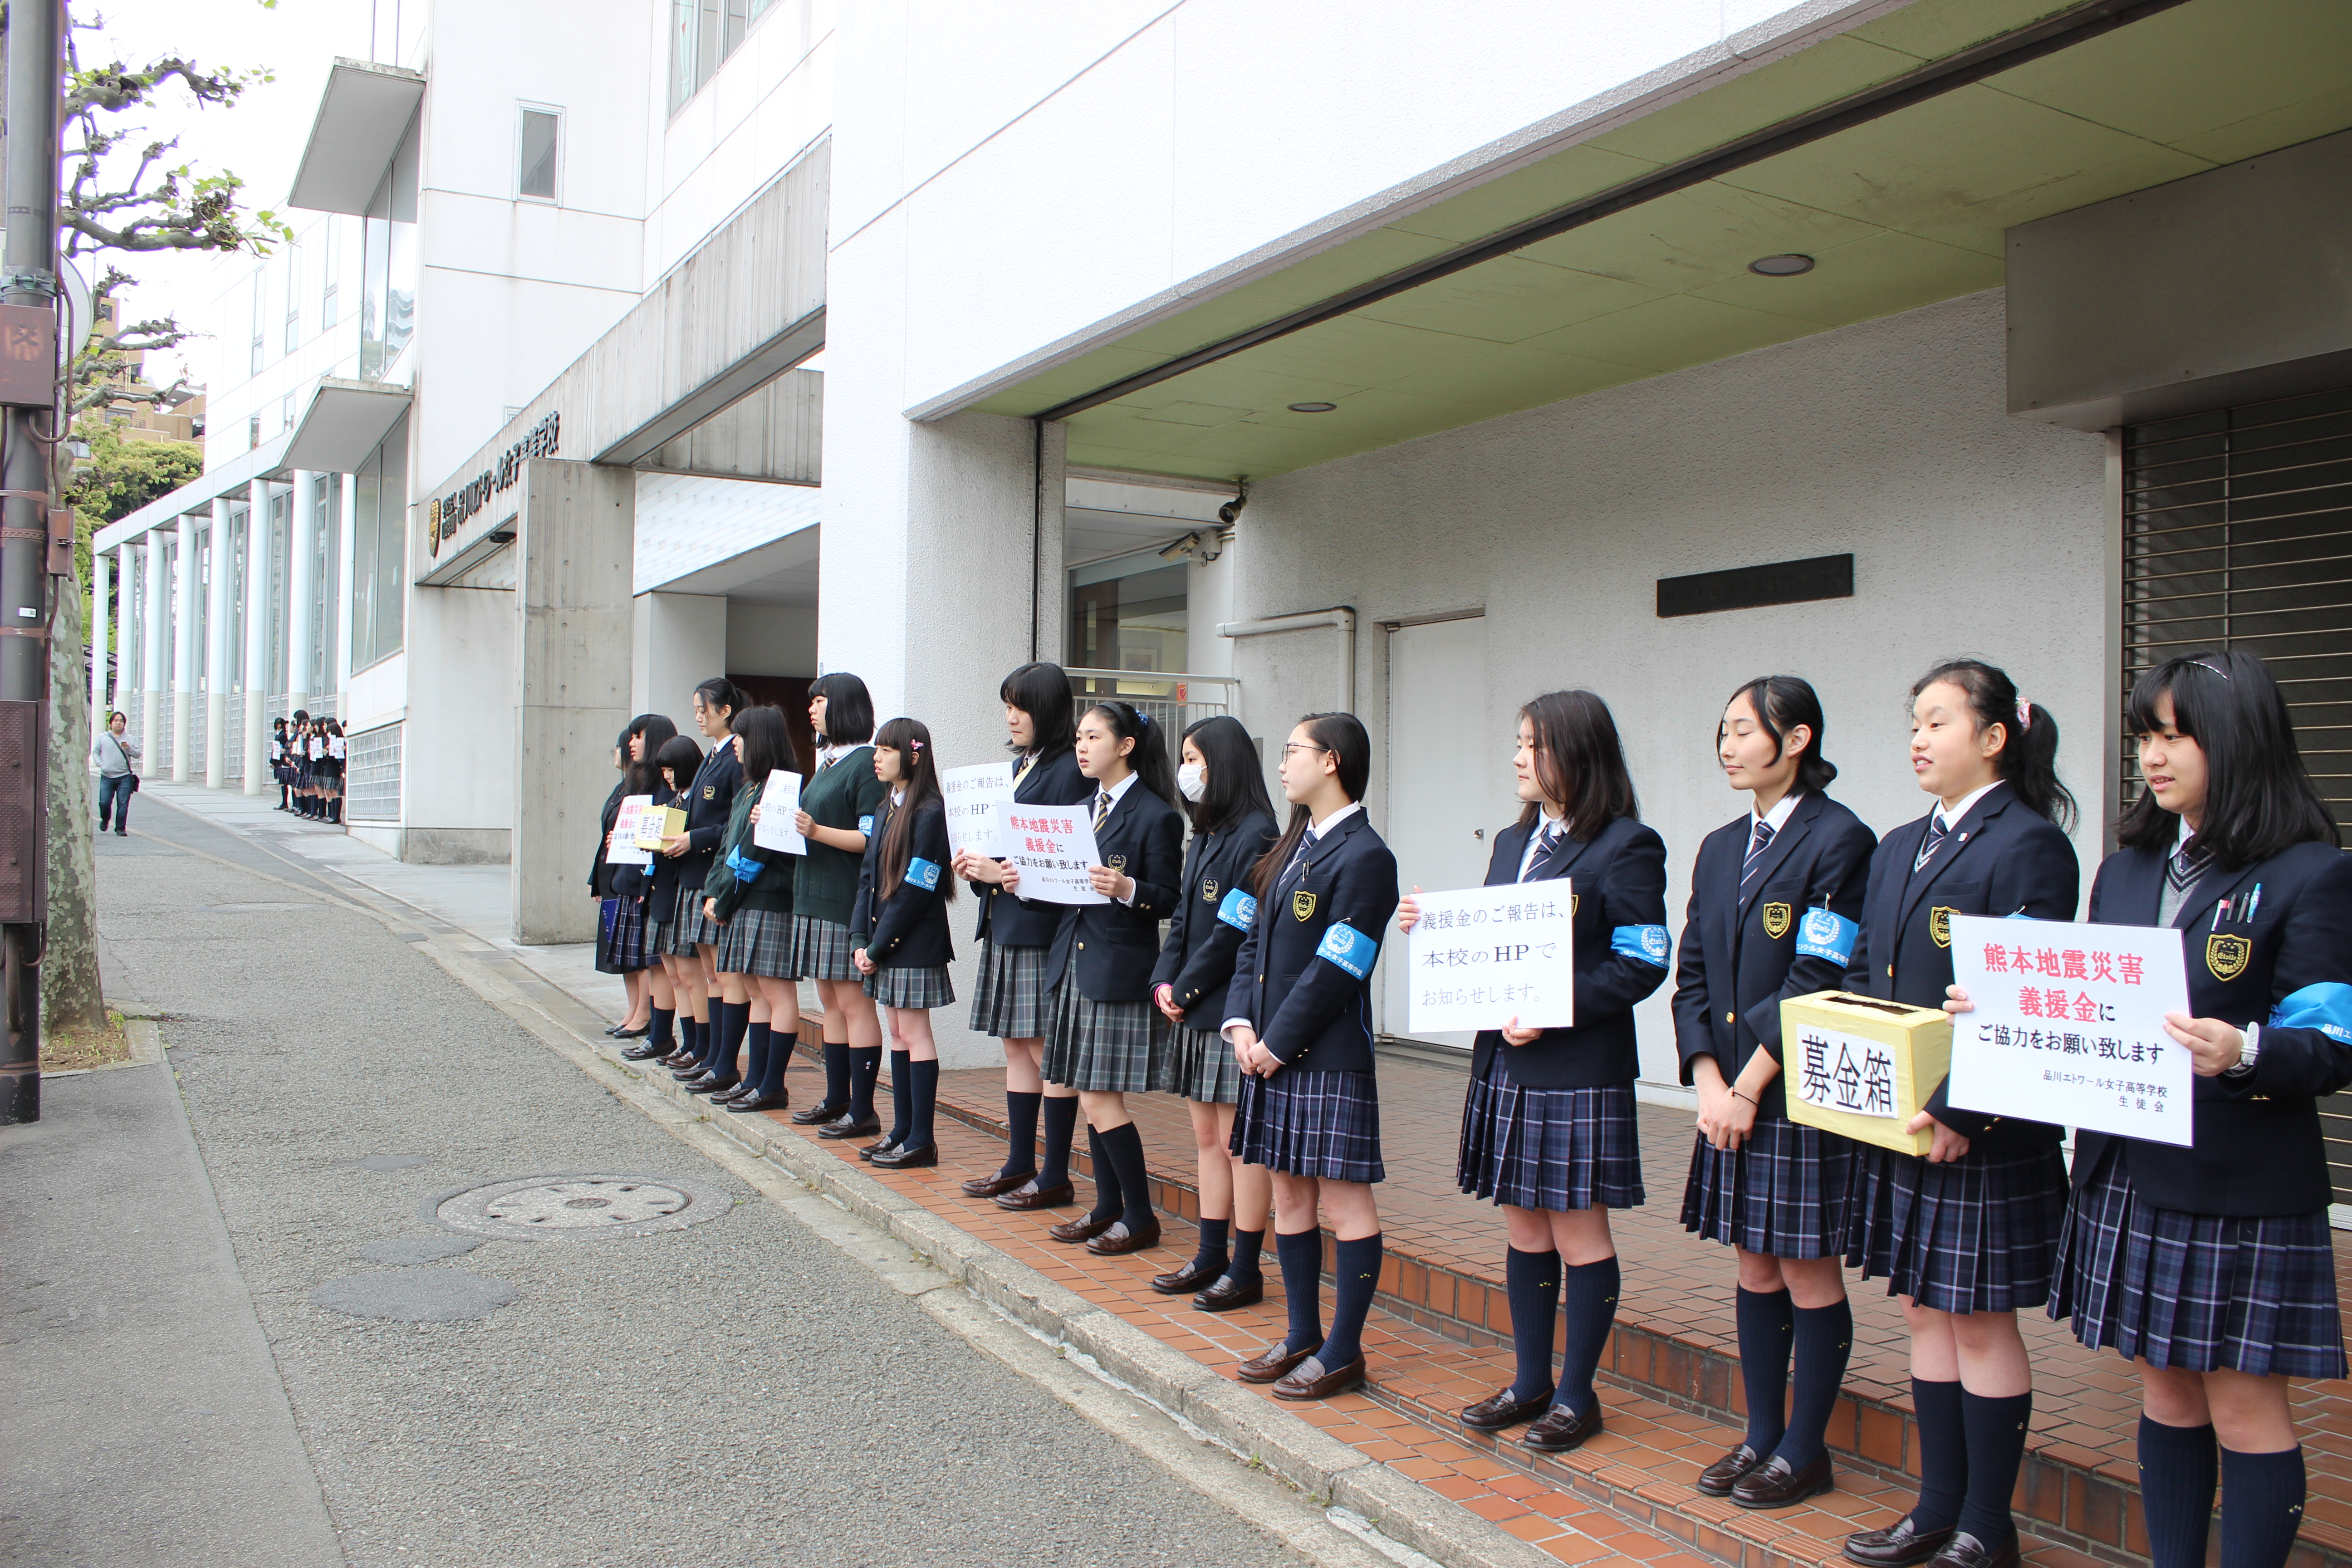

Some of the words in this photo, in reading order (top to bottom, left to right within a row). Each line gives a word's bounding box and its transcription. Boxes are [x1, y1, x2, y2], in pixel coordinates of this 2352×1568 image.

[946, 776, 1009, 794] 義援金のご報告は、
[948, 804, 996, 818] 本校のHP
[641, 814, 663, 838] 募金箱
[1010, 814, 1073, 834] 熊本地震災害
[1024, 836, 1064, 853] 義援金に
[1014, 855, 1088, 870] ご協力をお願い致します
[1422, 901, 1563, 930] 義援金のご報告は、
[1812, 922, 1831, 934] Etoile
[1422, 942, 1557, 968] 本校のHPで
[1983, 943, 2145, 985] 熊本地震災害
[2217, 952, 2237, 961] Etoile
[1422, 983, 1539, 1006] お知らせします。
[2019, 985, 2116, 1023] 義援金に
[1979, 1024, 2164, 1065] ご協力をお願い致します
[1802, 1034, 1892, 1113] 募金箱
[2043, 1069, 2168, 1098] 品川エトワール女子高等学校
